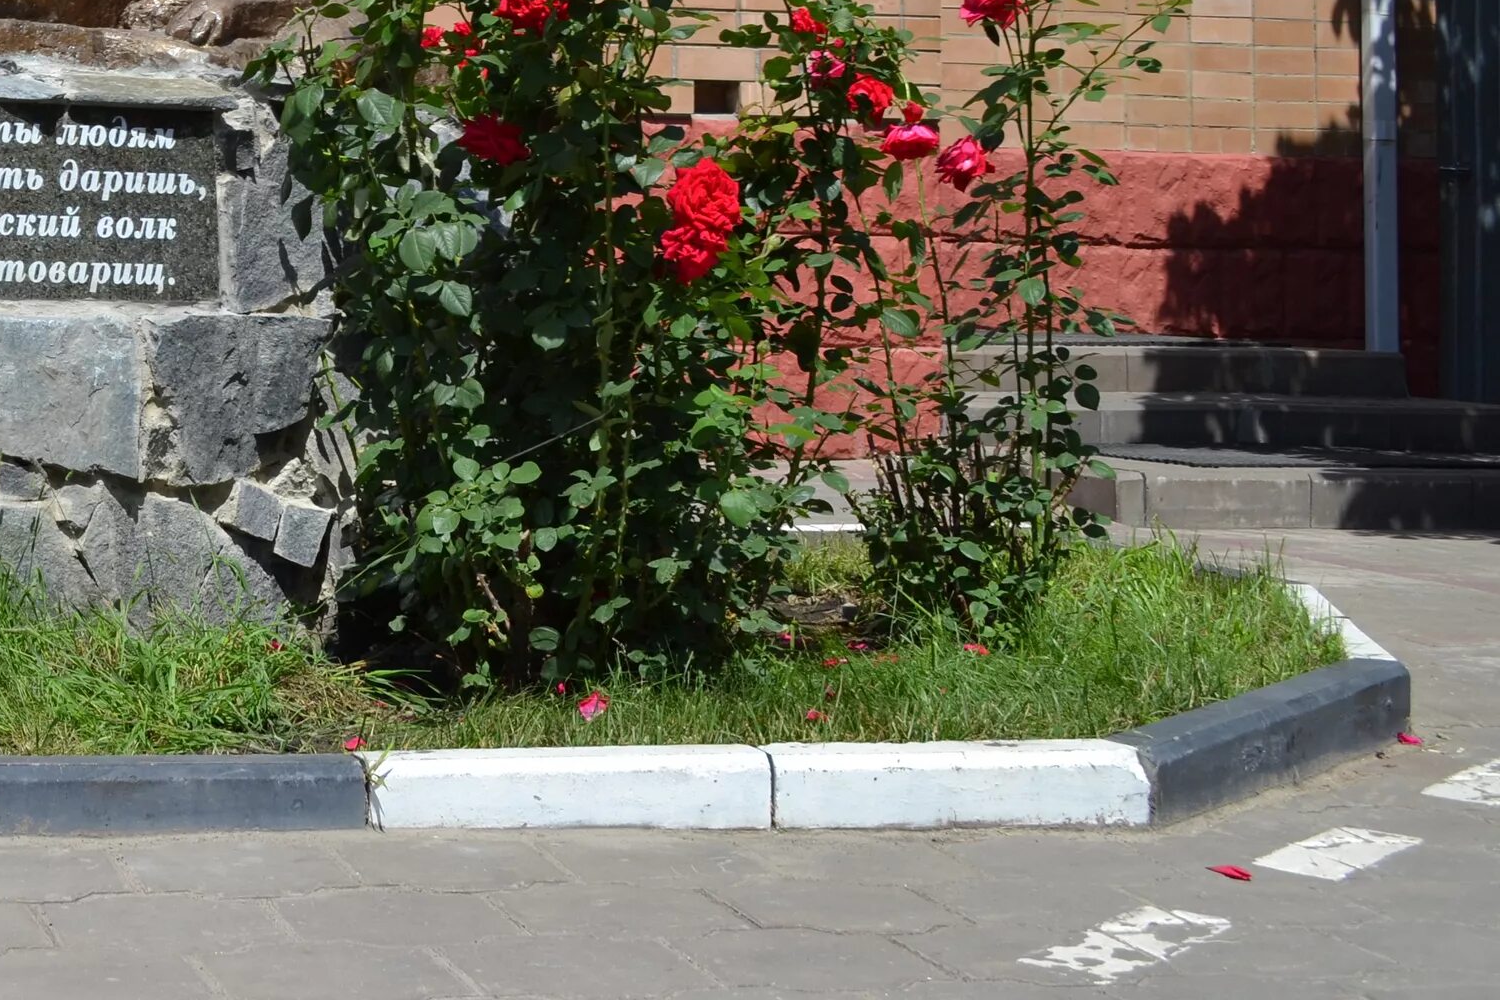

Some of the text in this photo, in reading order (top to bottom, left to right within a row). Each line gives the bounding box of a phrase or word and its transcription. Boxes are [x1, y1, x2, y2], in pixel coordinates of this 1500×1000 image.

[56, 115, 176, 149] людям
[59, 158, 207, 201] даришь,
[96, 215, 177, 241] волк
